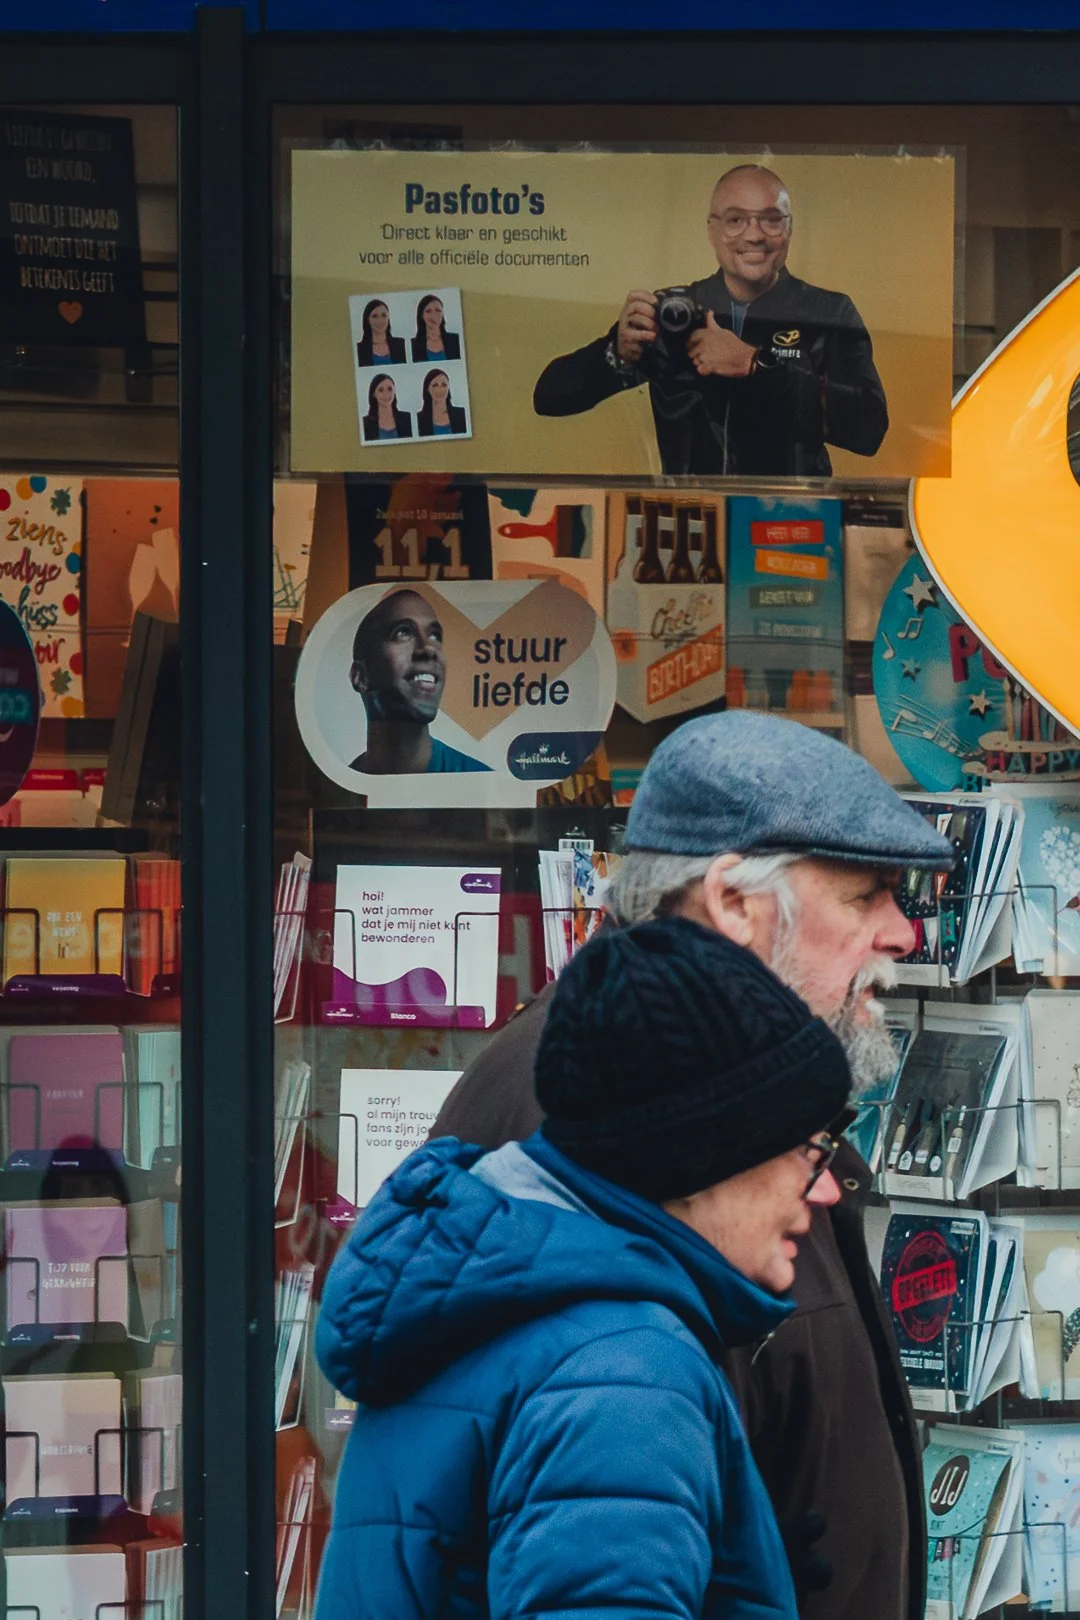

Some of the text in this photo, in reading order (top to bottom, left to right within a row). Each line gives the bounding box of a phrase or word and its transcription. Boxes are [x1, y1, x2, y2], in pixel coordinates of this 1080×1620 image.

[405, 183, 545, 215] Pasfoto's
[382, 224, 567, 245] Direct klaar en geschikt
[359, 249, 590, 267] voor alle officiële documenten
[6, 511, 68, 556] ziens
[12, 585, 59, 629] hüss
[35, 634, 66, 665] oir
[474, 633, 567, 664] stuur
[473, 672, 569, 708] liefde
[515, 751, 572, 771] Hallmark
[986, 750, 1080, 775] HAPPY
[362, 891, 384, 902] hoi!
[362, 905, 435, 918] wat jammer
[361, 919, 472, 933] dat je mij niet kunt
[361, 934, 436, 944] bewonderen
[367, 1096, 400, 1108] sorry!
[381, 1110, 406, 1122] mijn
[395, 1123, 414, 1136] zijn
[417, 1124, 431, 1136] jo
[366, 1139, 392, 1147] voor
[930, 1466, 968, 1507] JIJ
